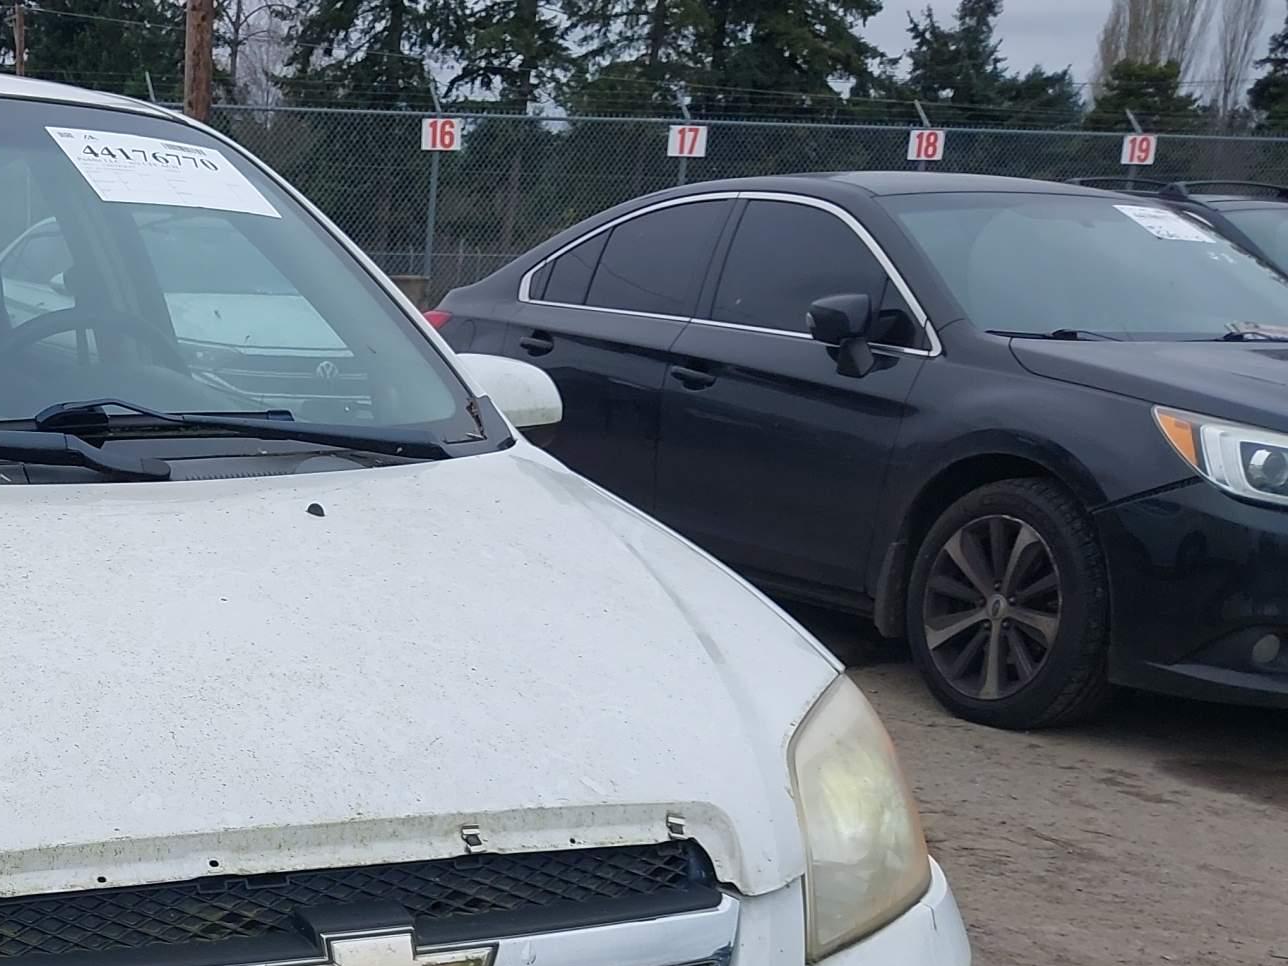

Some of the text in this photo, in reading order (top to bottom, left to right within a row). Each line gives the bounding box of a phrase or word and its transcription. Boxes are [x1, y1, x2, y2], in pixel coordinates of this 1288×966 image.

[429, 120, 455, 149] 16
[678, 127, 700, 155] 17
[916, 131, 938, 159] 18
[82, 144, 219, 171] 44176770
[1128, 136, 1151, 164] 19
